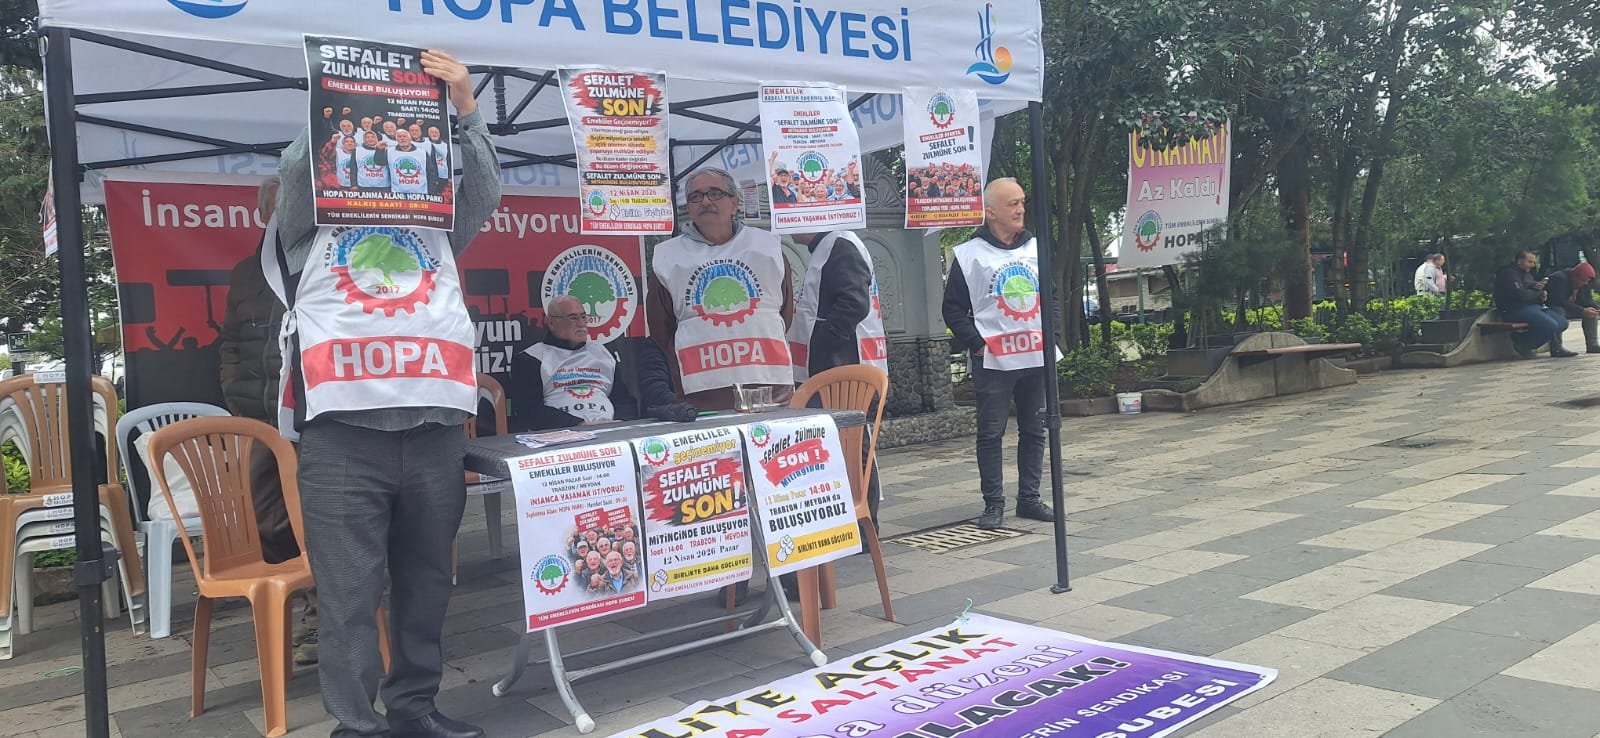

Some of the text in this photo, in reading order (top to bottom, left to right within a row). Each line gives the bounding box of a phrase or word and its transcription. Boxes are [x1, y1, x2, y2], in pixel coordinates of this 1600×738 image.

[388, 0, 912, 61] PA BELEDİYESİ
[320, 45, 413, 69] SEFALET
[321, 61, 438, 86] ZULMÜNE SON!
[583, 75, 634, 86] SEFALET
[327, 80, 431, 97] EMEKLİLER BULUŞUYOR!
[588, 87, 644, 98] ZULMÜNE
[602, 94, 655, 116] SON!
[922, 148, 952, 160] ZULMÜNE
[953, 145, 967, 154] SON
[929, 139, 956, 150] SEFALET
[613, 172, 645, 181] ZULMÜNE
[323, 190, 343, 198] HOPA
[345, 191, 381, 200] TOPLANMA
[407, 194, 425, 202] HOPA
[1137, 180, 1165, 202] Az
[142, 189, 579, 238] İnsanc stiyoru
[777, 212, 857, 224] İNSANCA YAŞAMAK İSTİYORUZ
[375, 286, 400, 295] 2017
[472, 319, 522, 348] yun
[1001, 333, 1042, 354] HOP
[333, 341, 449, 378] HOPA
[699, 341, 766, 369] HOPA
[560, 403, 607, 413] HOPA
[518, 455, 555, 469] SEFALET
[558, 448, 598, 463] ZULMÜNE
[599, 447, 617, 457] SON
[673, 439, 737, 464] geçinemiyor
[777, 451, 809, 469] SON
[529, 460, 616, 479] EMEKLİLER BULUŞUYOR
[659, 461, 717, 488] SEFALET
[549, 478, 564, 487] NİSAN
[565, 477, 581, 485] PAZAR
[552, 485, 576, 494] TRABZON
[663, 474, 732, 505] ZULMÜNE
[809, 482, 831, 495] 14:00
[530, 494, 559, 506] İNSANCA
[681, 481, 742, 524] SON!
[769, 503, 798, 516] TRABZON
[804, 494, 831, 507] MEYDAN
[769, 502, 848, 533] BULUŞUYORUZ
[649, 519, 749, 546] MİTİNGİNDE BULUŞUYOR
[690, 537, 717, 548] TRABZON
[724, 530, 749, 542] MEYDAN
[663, 544, 740, 566] 12 Nisan 2026 Pazar
[797, 540, 818, 553] BİRLİKTE
[703, 565, 720, 574] DAHA
[628, 627, 988, 738] LİYE AÇLIK
[776, 636, 1019, 724] SALTANAT
[889, 645, 1083, 715] düzeni
[1076, 671, 1190, 718] SENDİKASI
